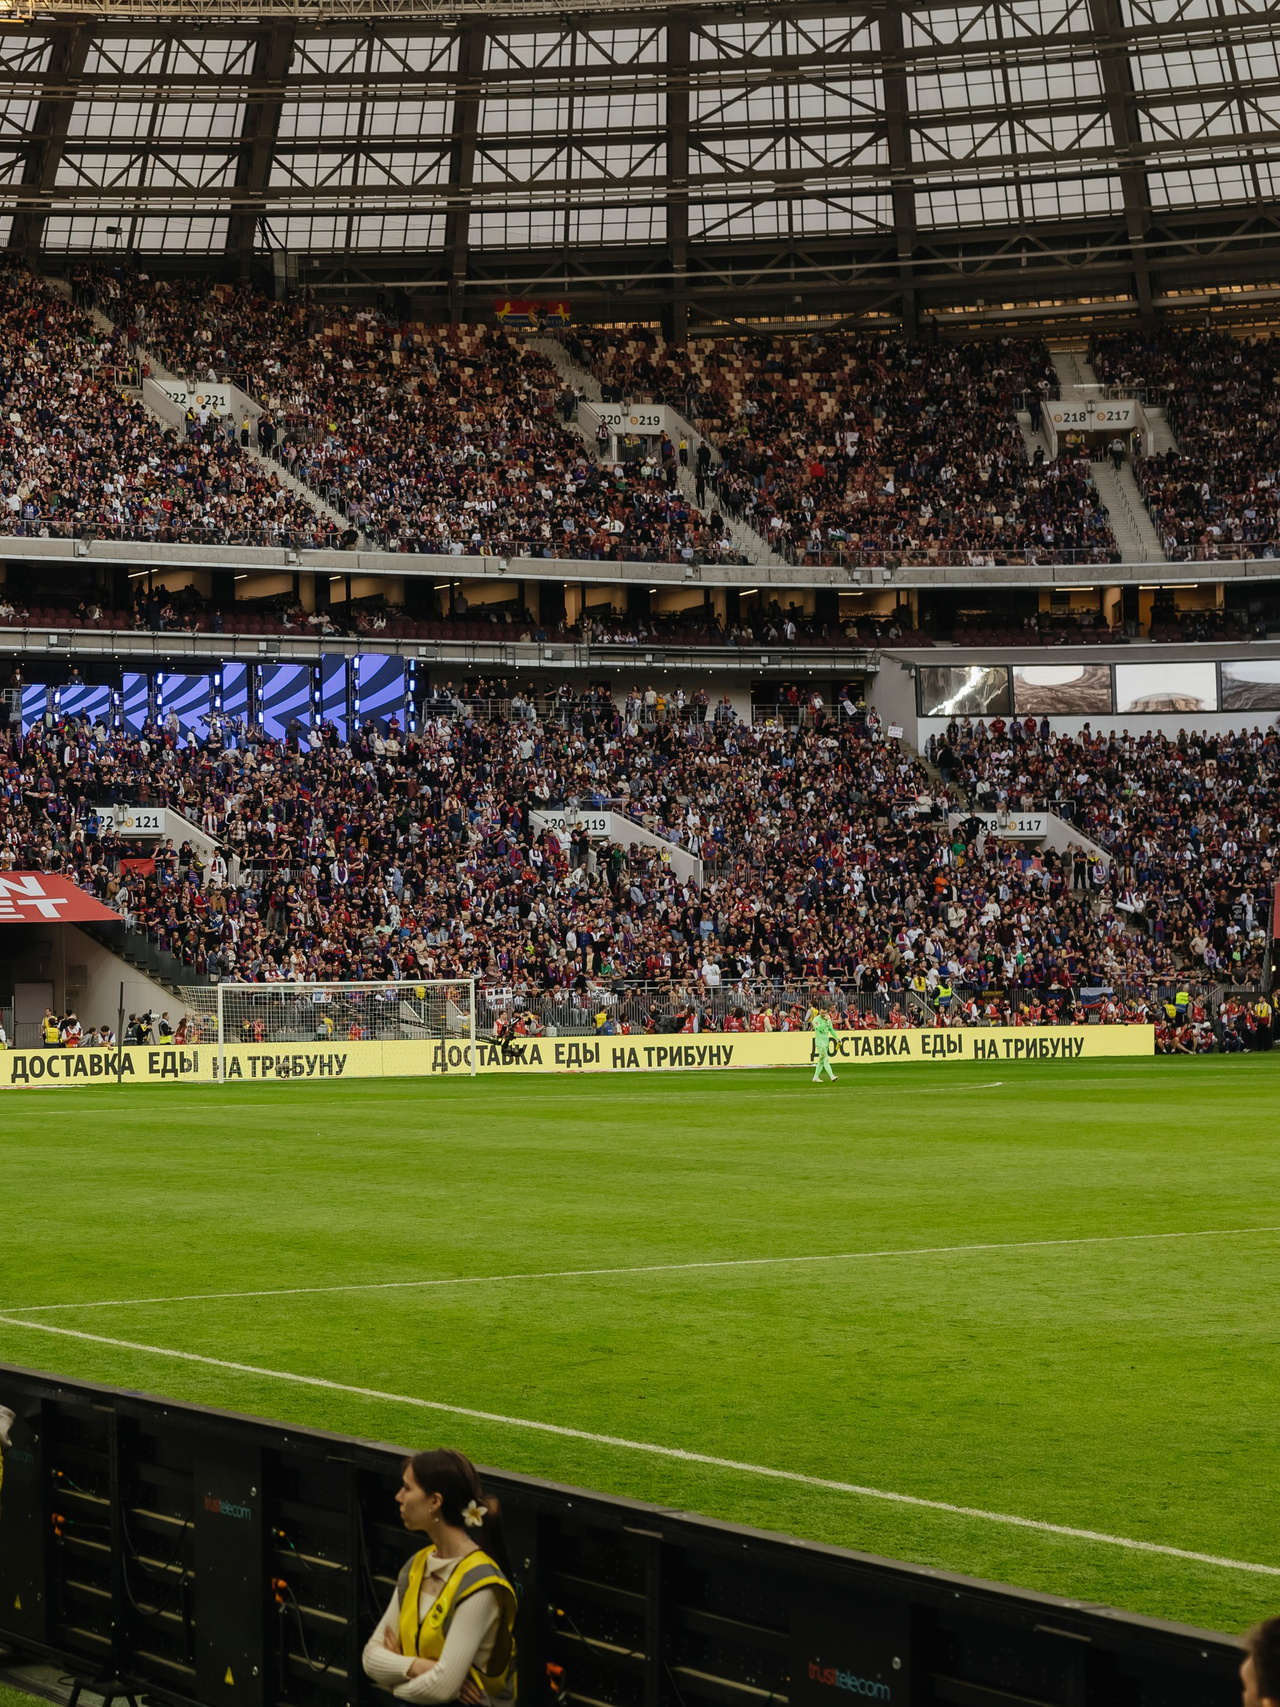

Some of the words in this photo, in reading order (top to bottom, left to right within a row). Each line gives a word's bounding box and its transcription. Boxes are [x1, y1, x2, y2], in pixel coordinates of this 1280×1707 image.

[205, 395, 226, 406] 221
[639, 415, 660, 426] 219
[1063, 412, 1086, 422] 218
[1106, 410, 1130, 421] 217
[101, 816, 114, 828] 22
[135, 816, 159, 828] 121
[584, 819, 606, 831] 119
[982, 820, 998, 831] 18
[1018, 820, 1041, 831] 117
[921, 1034, 962, 1058] ЕДЫ
[973, 1039, 999, 1059] НА
[1002, 1037, 1084, 1059] ТРИБУНУ
[555, 1042, 600, 1068] ЕДЫ
[612, 1047, 640, 1068] НА
[643, 1045, 734, 1067] ТРИБУНУ
[11, 1052, 135, 1083] ДОСТАВКА
[148, 1051, 198, 1078] ЕДЫ
[212, 1056, 243, 1079] НА
[247, 1053, 347, 1077] ТРИБУНУ
